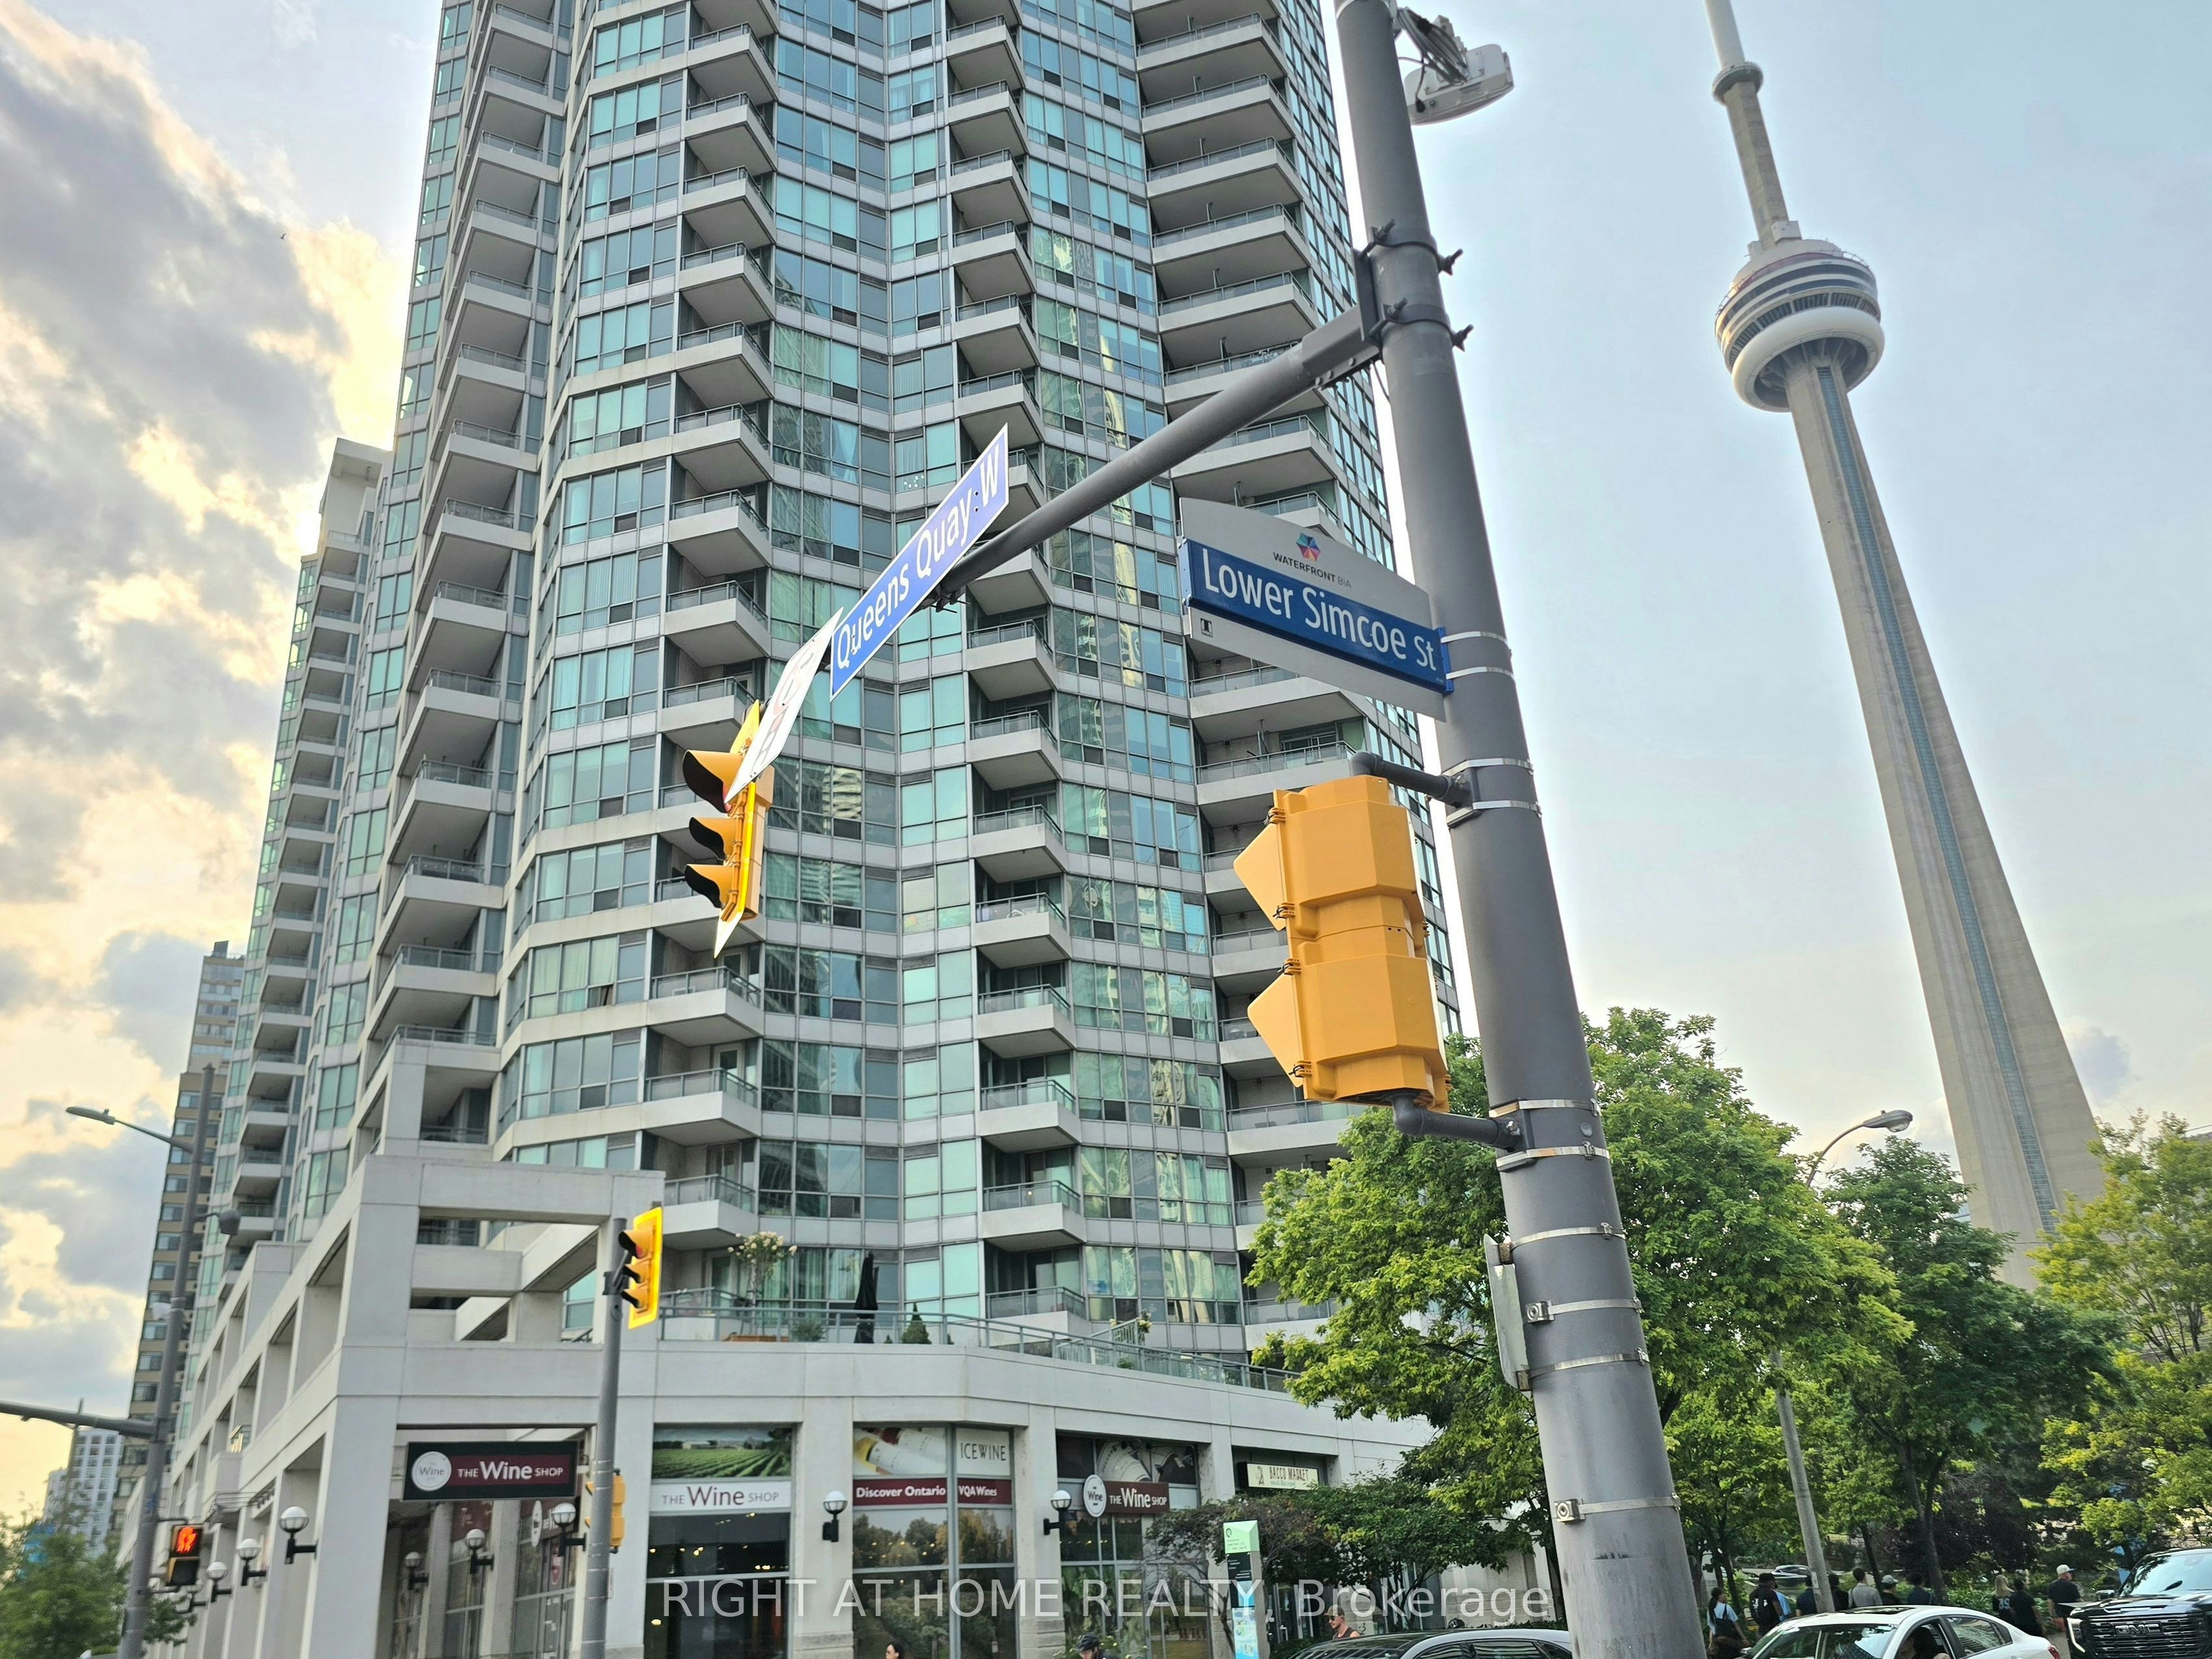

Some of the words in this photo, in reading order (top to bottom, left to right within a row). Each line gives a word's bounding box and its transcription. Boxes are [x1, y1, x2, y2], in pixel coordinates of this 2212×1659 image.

[837, 561, 910, 669] Queens
[916, 488, 972, 578] Quay
[979, 444, 1000, 507] W
[1273, 552, 1336, 583] WATERFRONT
[1338, 576, 1352, 589] BIA
[1202, 548, 1293, 619] Lower
[1302, 586, 1407, 660] Simcoe
[1414, 635, 1436, 671] St
[960, 1442, 1007, 1461] ICEWINE
[418, 1466, 445, 1476] Wine
[457, 1468, 479, 1478] THE
[479, 1461, 533, 1480] Wine
[534, 1467, 564, 1477] SHOP
[662, 1494, 685, 1505] THE
[687, 1485, 744, 1506] Wine
[748, 1492, 779, 1502] SHOP
[856, 1487, 903, 1498] Discover
[904, 1485, 946, 1496] Ontario
[958, 1485, 976, 1497] VQA
[1087, 1490, 1103, 1502] Wine
[1109, 1495, 1122, 1505] THE
[1120, 1487, 1151, 1508] Wine
[1152, 1496, 1168, 1506] SHOP
[2115, 1623, 2161, 1634] GMC
